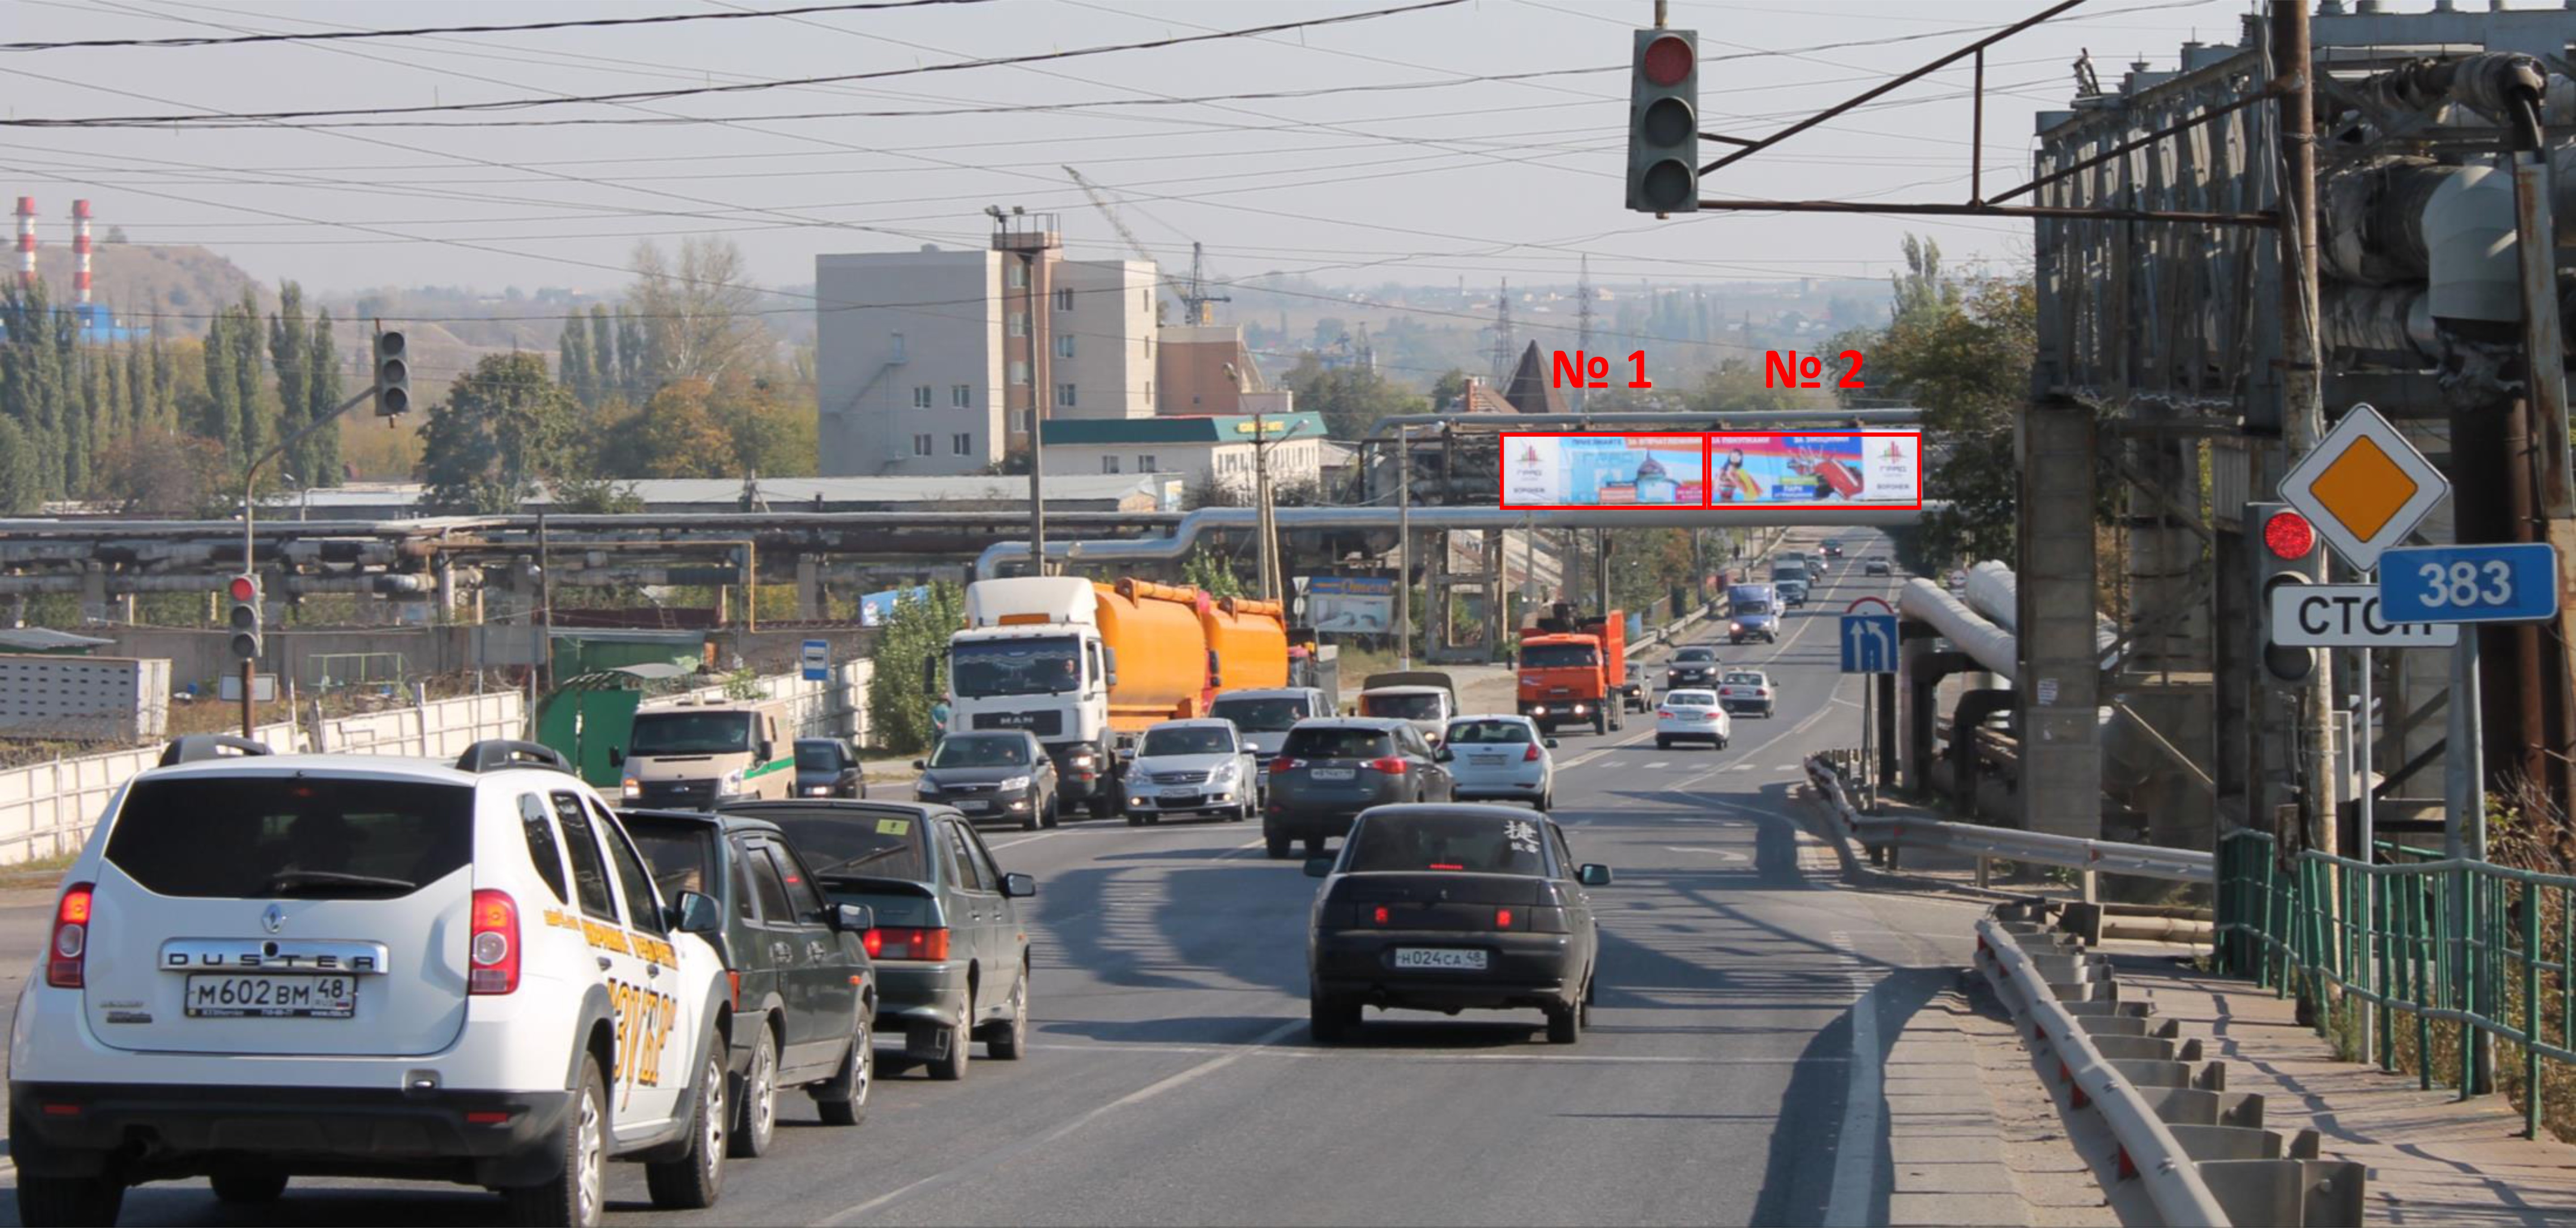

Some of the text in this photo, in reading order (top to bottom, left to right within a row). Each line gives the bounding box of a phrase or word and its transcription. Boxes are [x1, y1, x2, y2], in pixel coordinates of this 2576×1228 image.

[2419, 560, 2512, 607] 383
[1000, 716, 1034, 725] MAN
[168, 953, 375, 970] DUSTER
[1402, 951, 1461, 965] Н024СА
[198, 979, 344, 1005] М602ВМ 48
